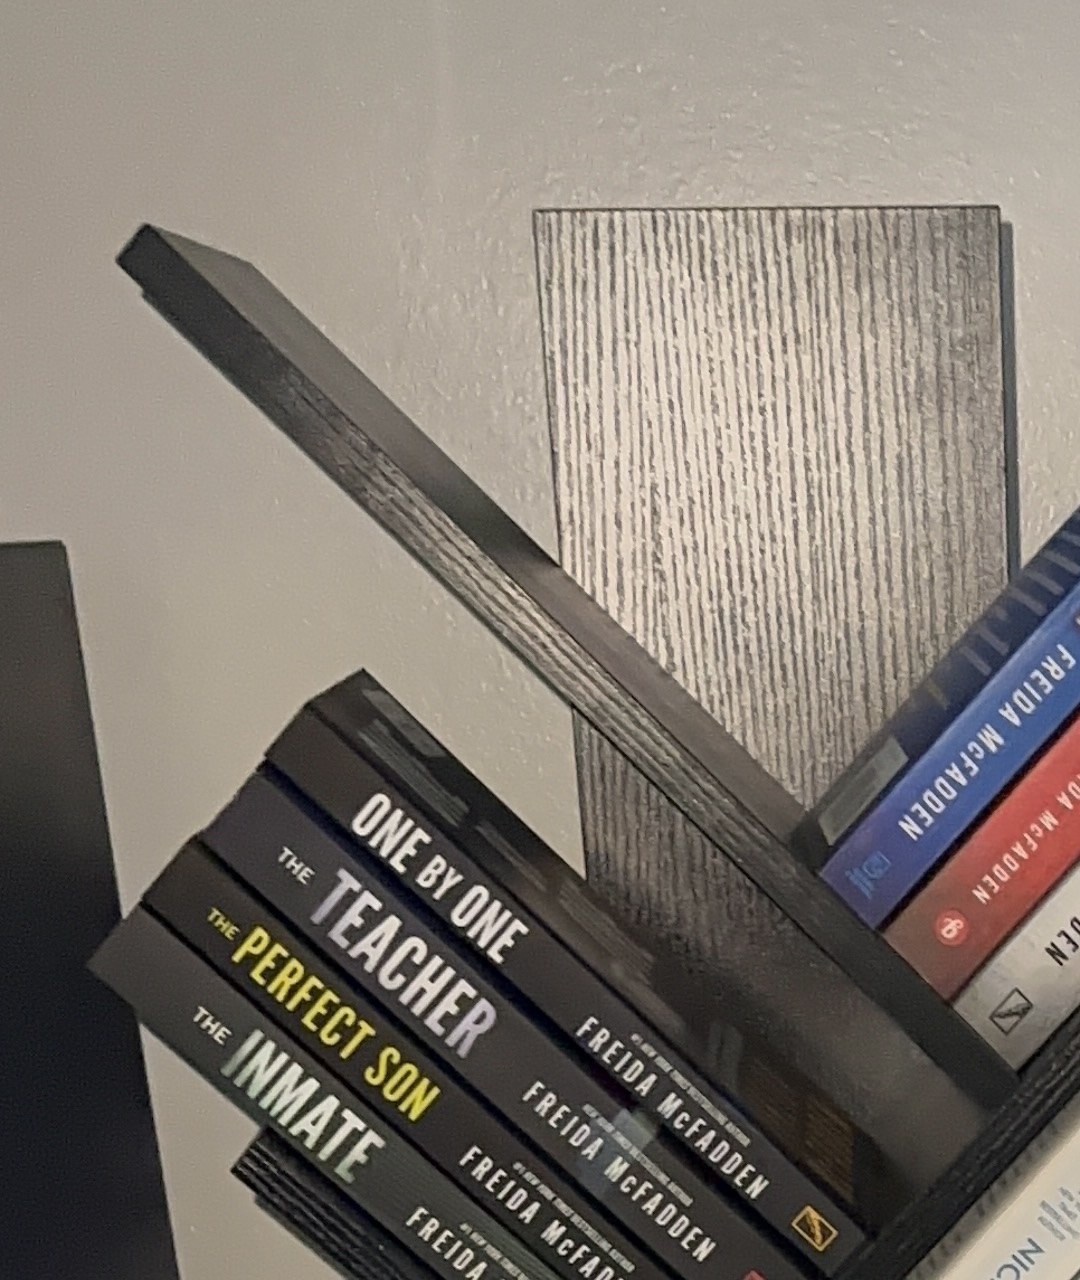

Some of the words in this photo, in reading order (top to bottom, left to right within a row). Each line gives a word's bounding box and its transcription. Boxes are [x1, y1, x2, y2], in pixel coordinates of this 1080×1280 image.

[999, 643, 1077, 727] FREIDA
[898, 723, 1004, 841] McFADDEN
[972, 810, 1059, 905] McFADDEN
[278, 846, 317, 885] THE
[310, 868, 497, 1060] TEACHER
[351, 793, 432, 874] ONE
[416, 854, 464, 900] BY
[450, 884, 529, 965] ONE
[193, 1006, 233, 1045] THE
[220, 1029, 386, 1184] INMATE
[207, 907, 241, 942] THE
[232, 926, 376, 1060] PERFECT
[365, 1047, 441, 1122] SON
[459, 1145, 541, 1224] FREIDA
[522, 1080, 604, 1160] FREIDA
[604, 1155, 717, 1263] McFADDEN
[576, 1015, 657, 1098] FREIDA
[657, 1092, 770, 1200] McFADDEN
